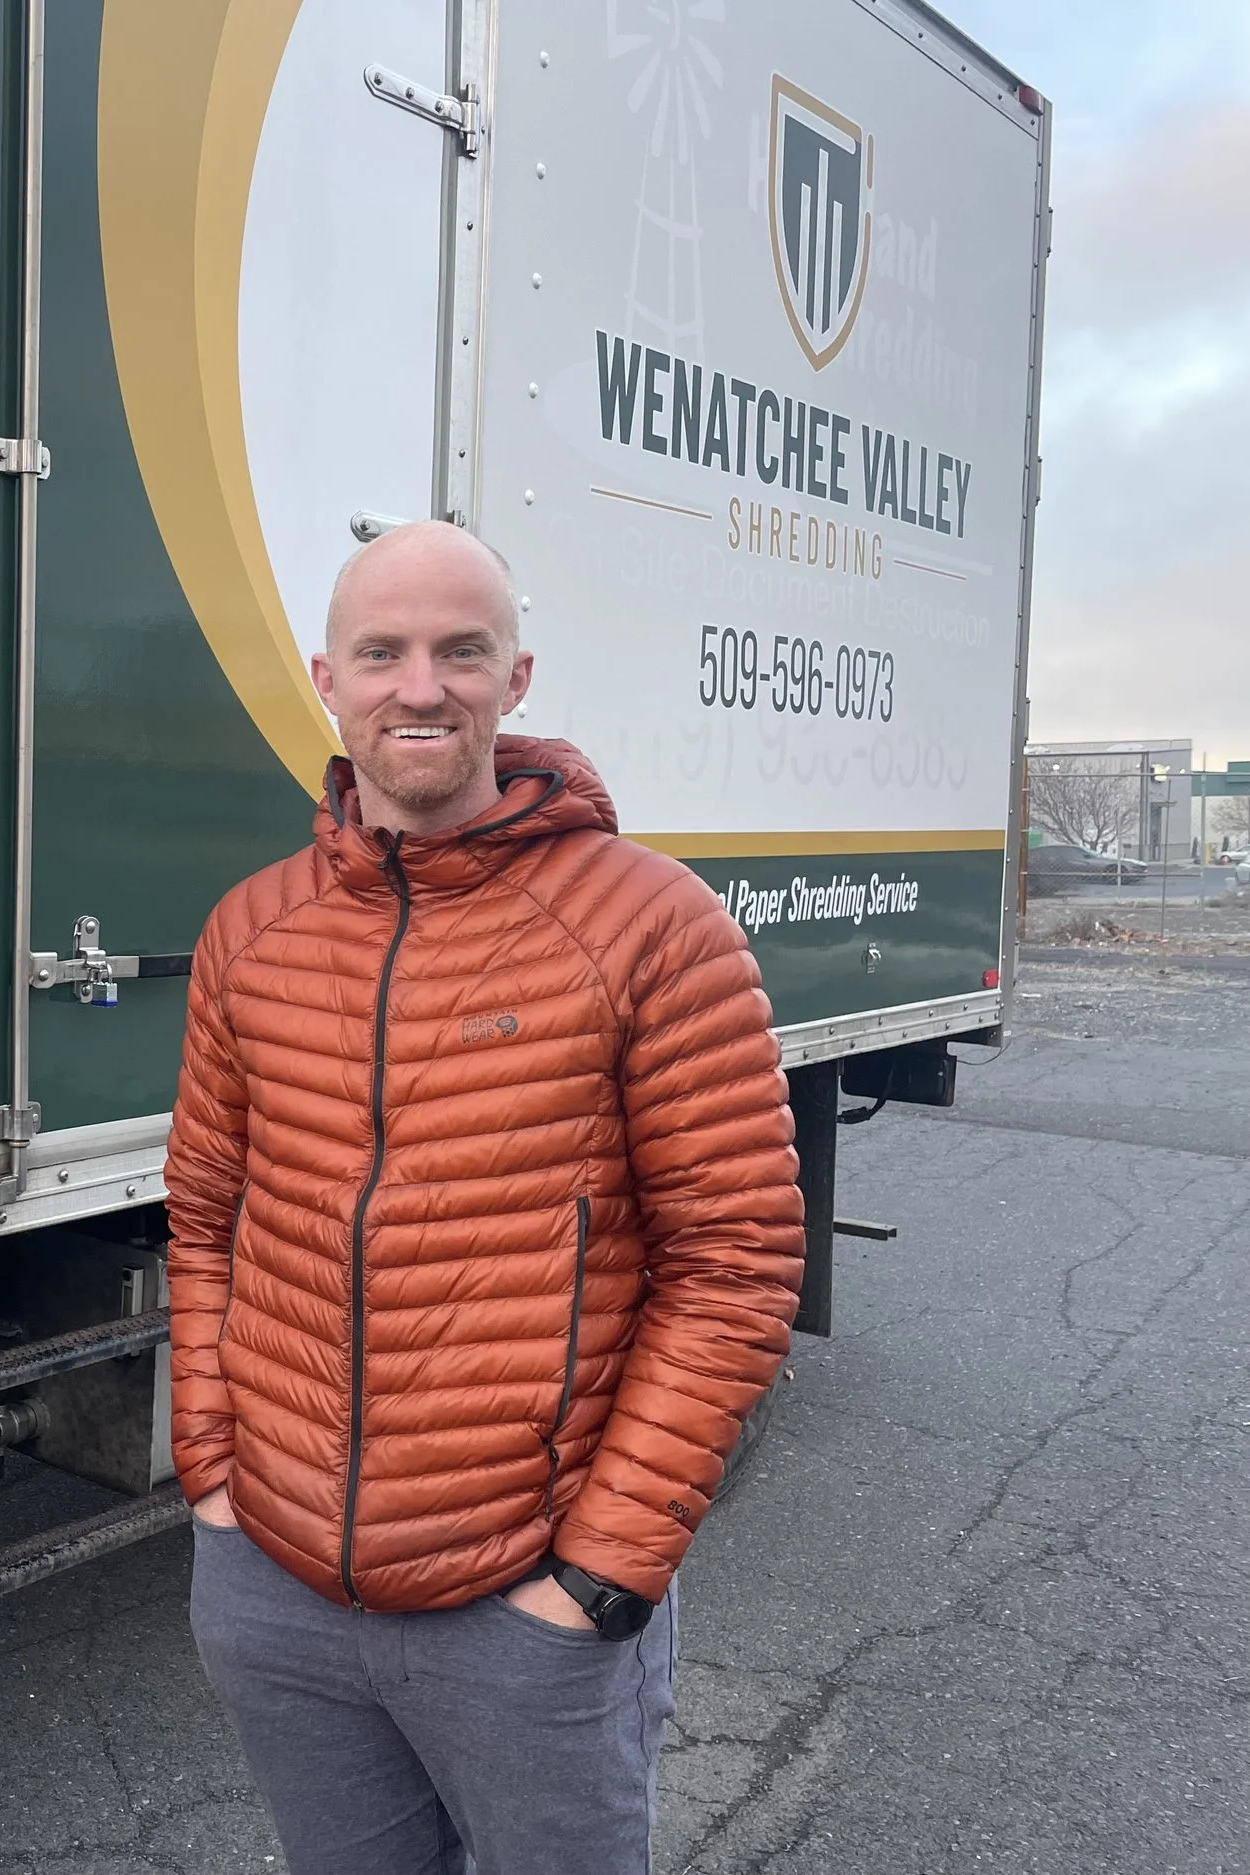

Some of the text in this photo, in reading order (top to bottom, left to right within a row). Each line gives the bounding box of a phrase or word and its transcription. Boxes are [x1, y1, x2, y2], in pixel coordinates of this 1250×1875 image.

[596, 330, 972, 538] WENATCHEE VALLEY
[728, 497, 883, 580] SHREDDING
[699, 625, 894, 722] 509-596-0973
[735, 879, 787, 934] Paper
[788, 875, 866, 925] Shredding
[867, 872, 918, 916] Service
[667, 1500, 690, 1518] 800
